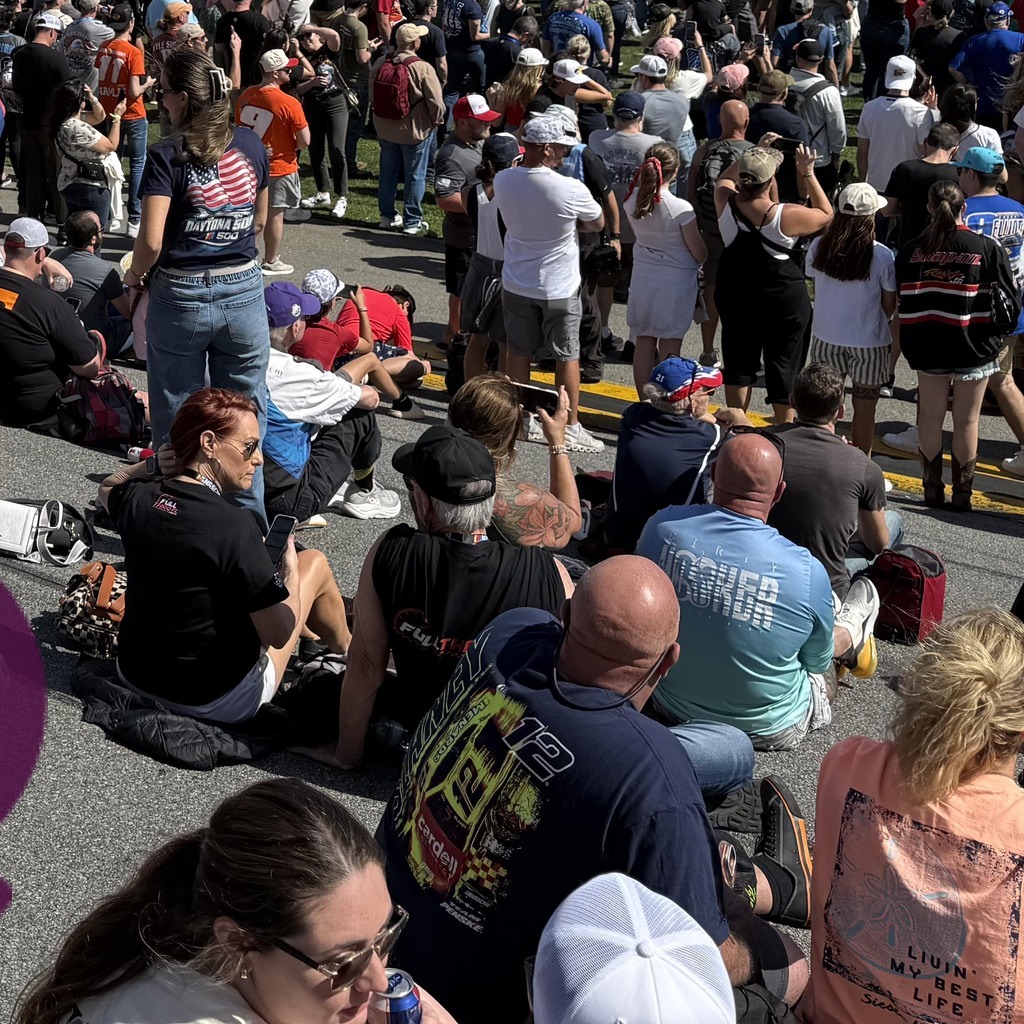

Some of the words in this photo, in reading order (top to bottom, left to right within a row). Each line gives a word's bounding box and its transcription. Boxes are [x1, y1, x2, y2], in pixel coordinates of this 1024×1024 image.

[98, 55, 125, 84] 11
[239, 105, 275, 141] 9
[184, 217, 231, 232] DAYTONA
[399, 621, 440, 651] FULL
[502, 716, 576, 782] 12
[439, 901, 484, 934] PENSKE
[449, 900, 482, 922] TEAM
[890, 957, 922, 980] MY
[913, 987, 964, 1017] LIFE
[934, 977, 994, 1007] BEST
